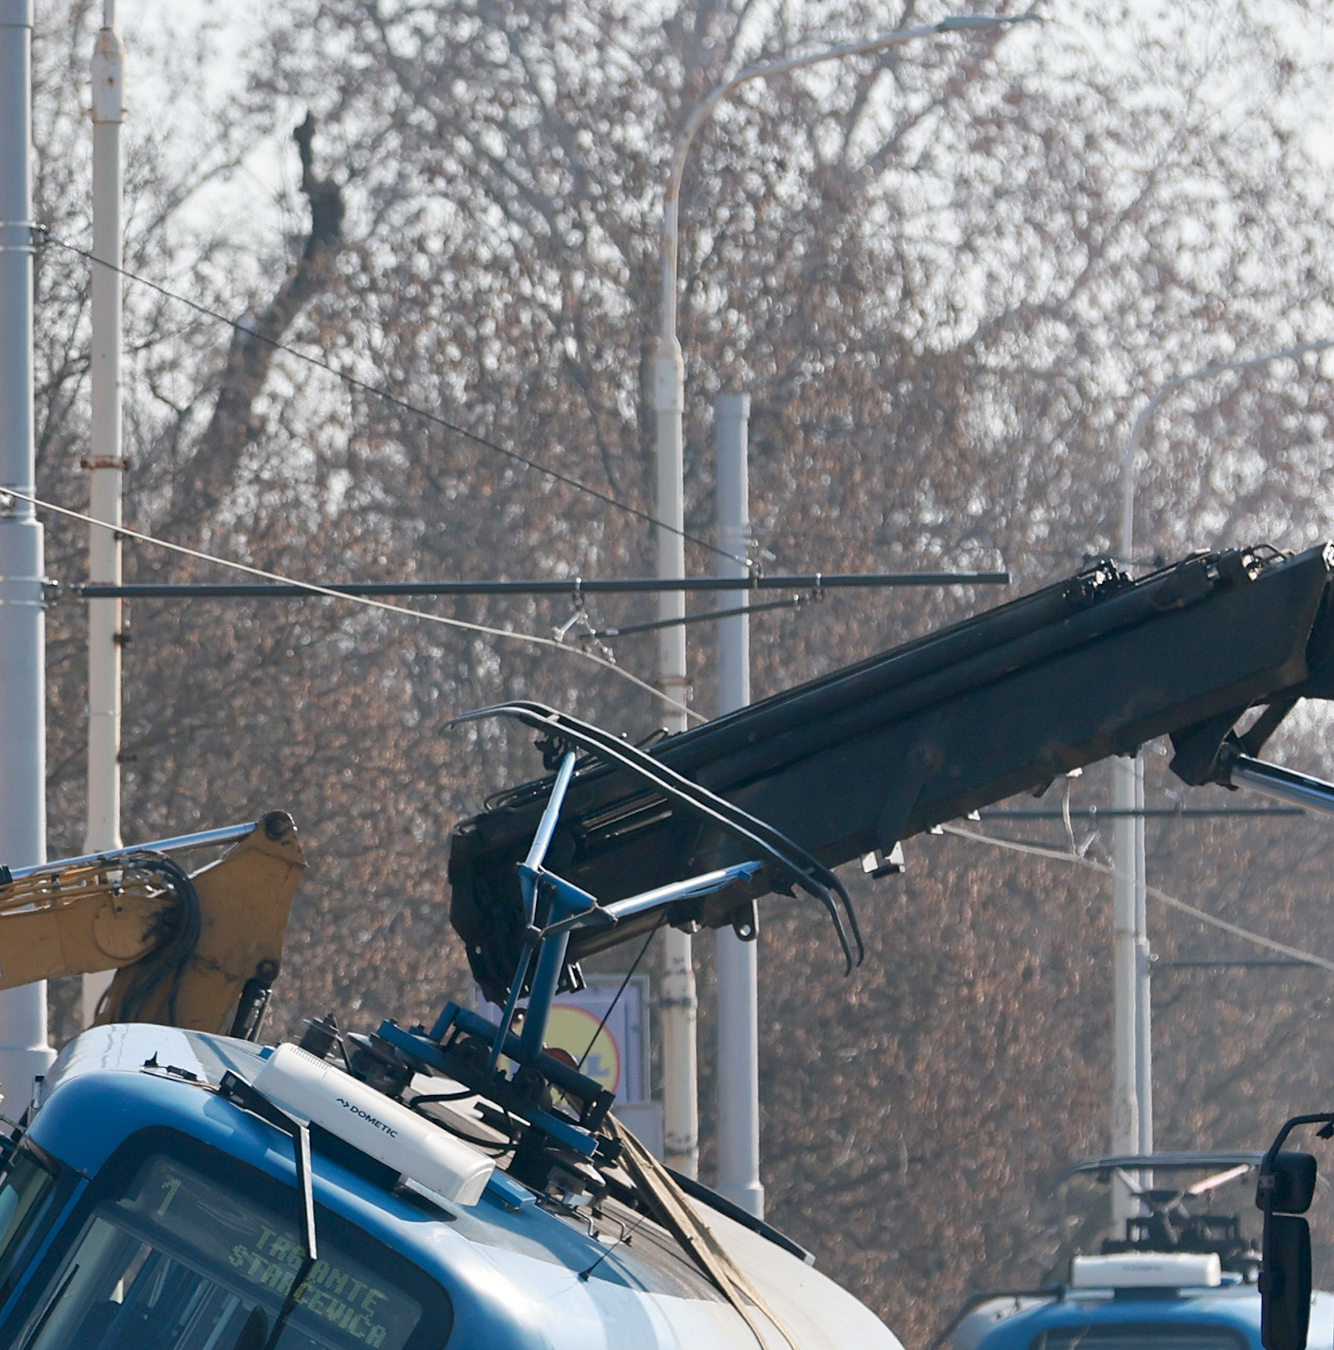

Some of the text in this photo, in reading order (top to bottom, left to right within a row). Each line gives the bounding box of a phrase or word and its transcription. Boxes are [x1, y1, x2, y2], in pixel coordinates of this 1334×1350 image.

[349, 1105, 399, 1139] DOMETIC
[157, 1178, 182, 1218] 1
[309, 1259, 380, 1309] ANTE
